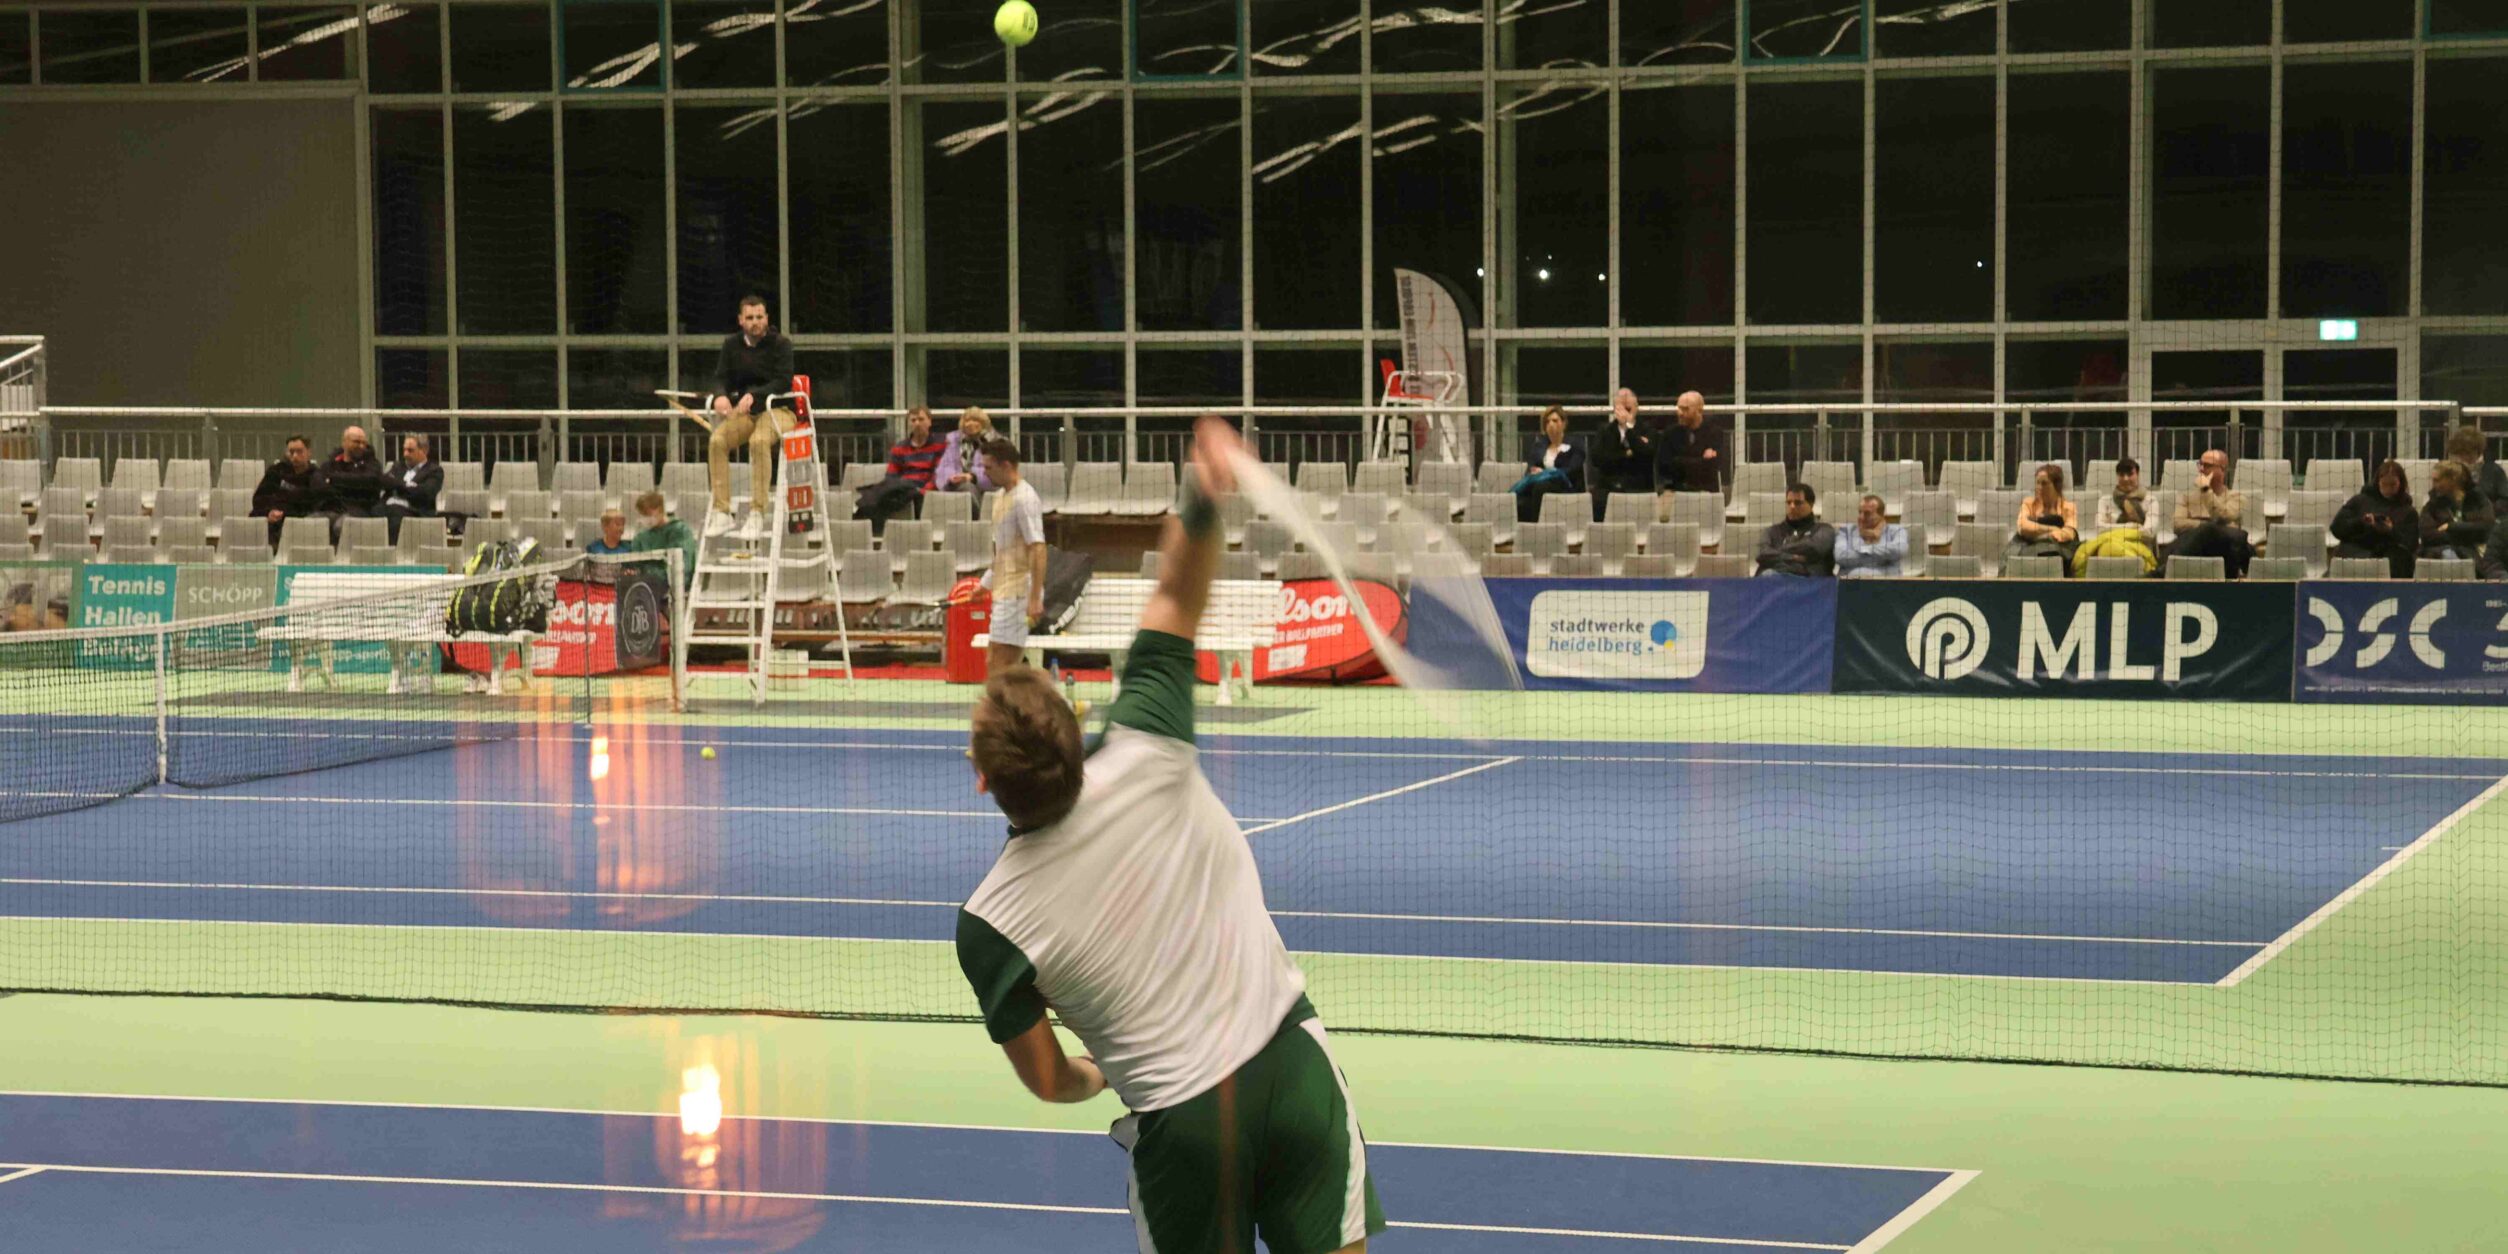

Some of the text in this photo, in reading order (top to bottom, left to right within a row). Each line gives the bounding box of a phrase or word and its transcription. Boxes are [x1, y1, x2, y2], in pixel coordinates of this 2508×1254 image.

[88, 575, 166, 596] Tennis
[188, 583, 263, 604] SCHÖPP
[85, 606, 162, 626] Hallen
[1275, 587, 1356, 625] lson
[1550, 618, 1645, 634] stadtwerke
[2306, 596, 2448, 670] DSC
[1549, 636, 1643, 656] heidelberg
[2017, 600, 2219, 682] MLP
